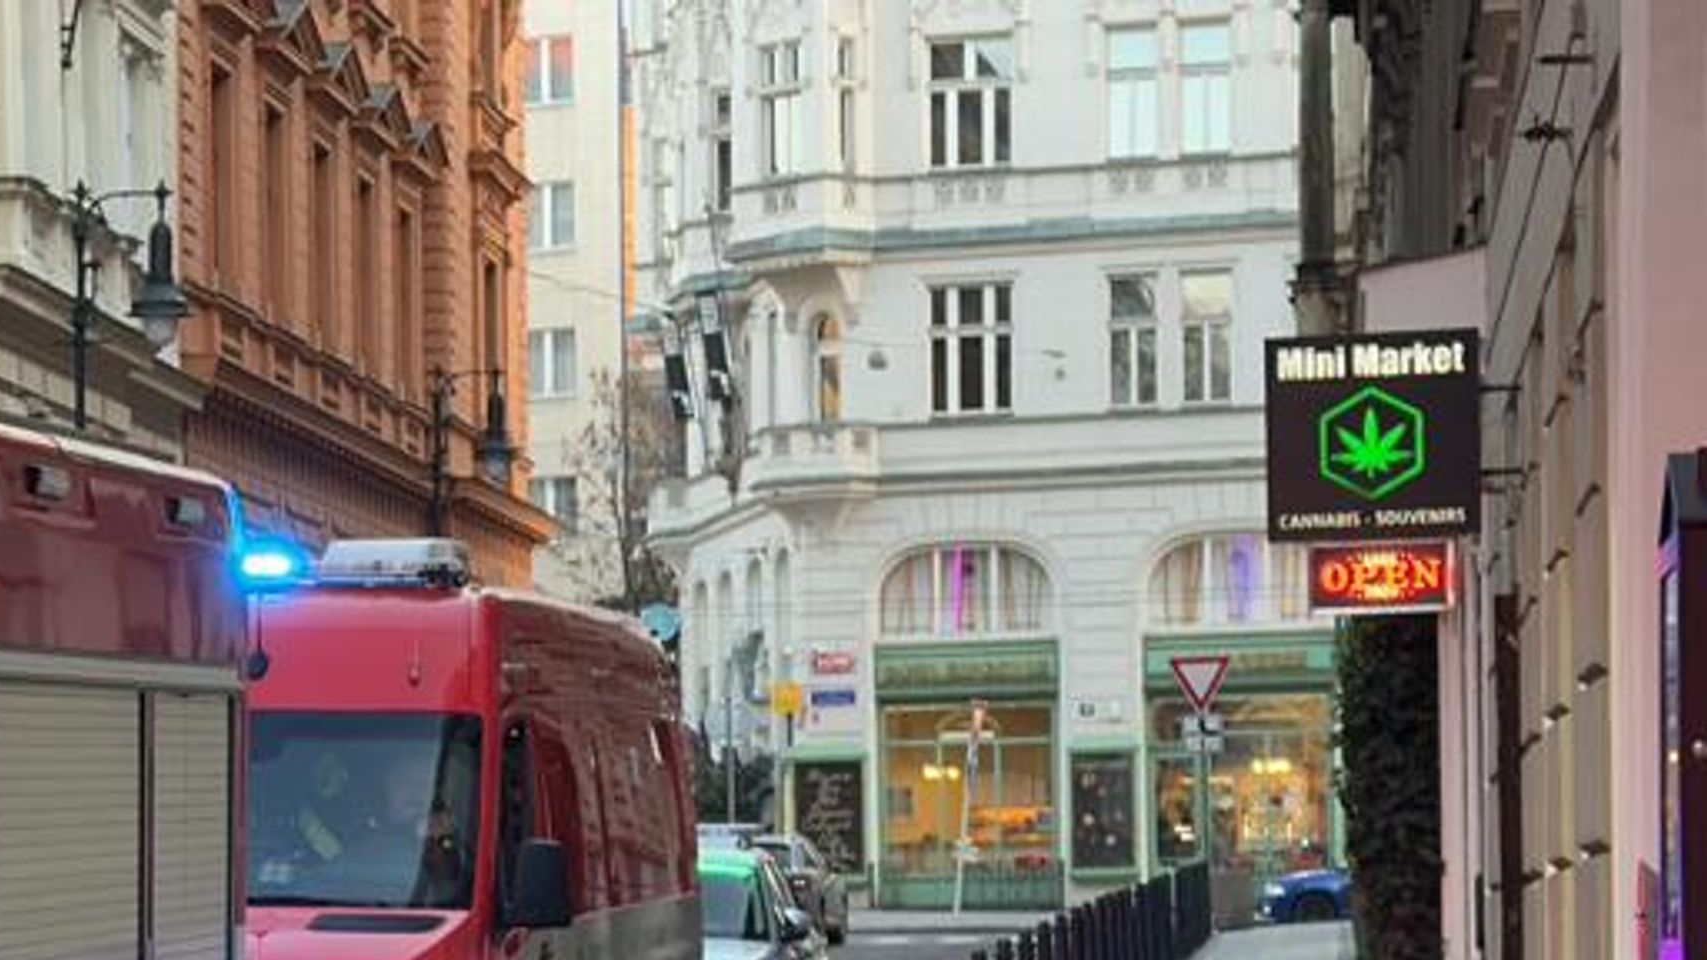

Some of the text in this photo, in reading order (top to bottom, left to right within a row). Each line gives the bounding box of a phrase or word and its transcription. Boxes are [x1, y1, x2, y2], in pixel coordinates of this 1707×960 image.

[1276, 342, 1466, 382] Mini Market
[1279, 506, 1466, 530] CANNABIS SOUVENIRS
[1320, 557, 1442, 592] OPEN
